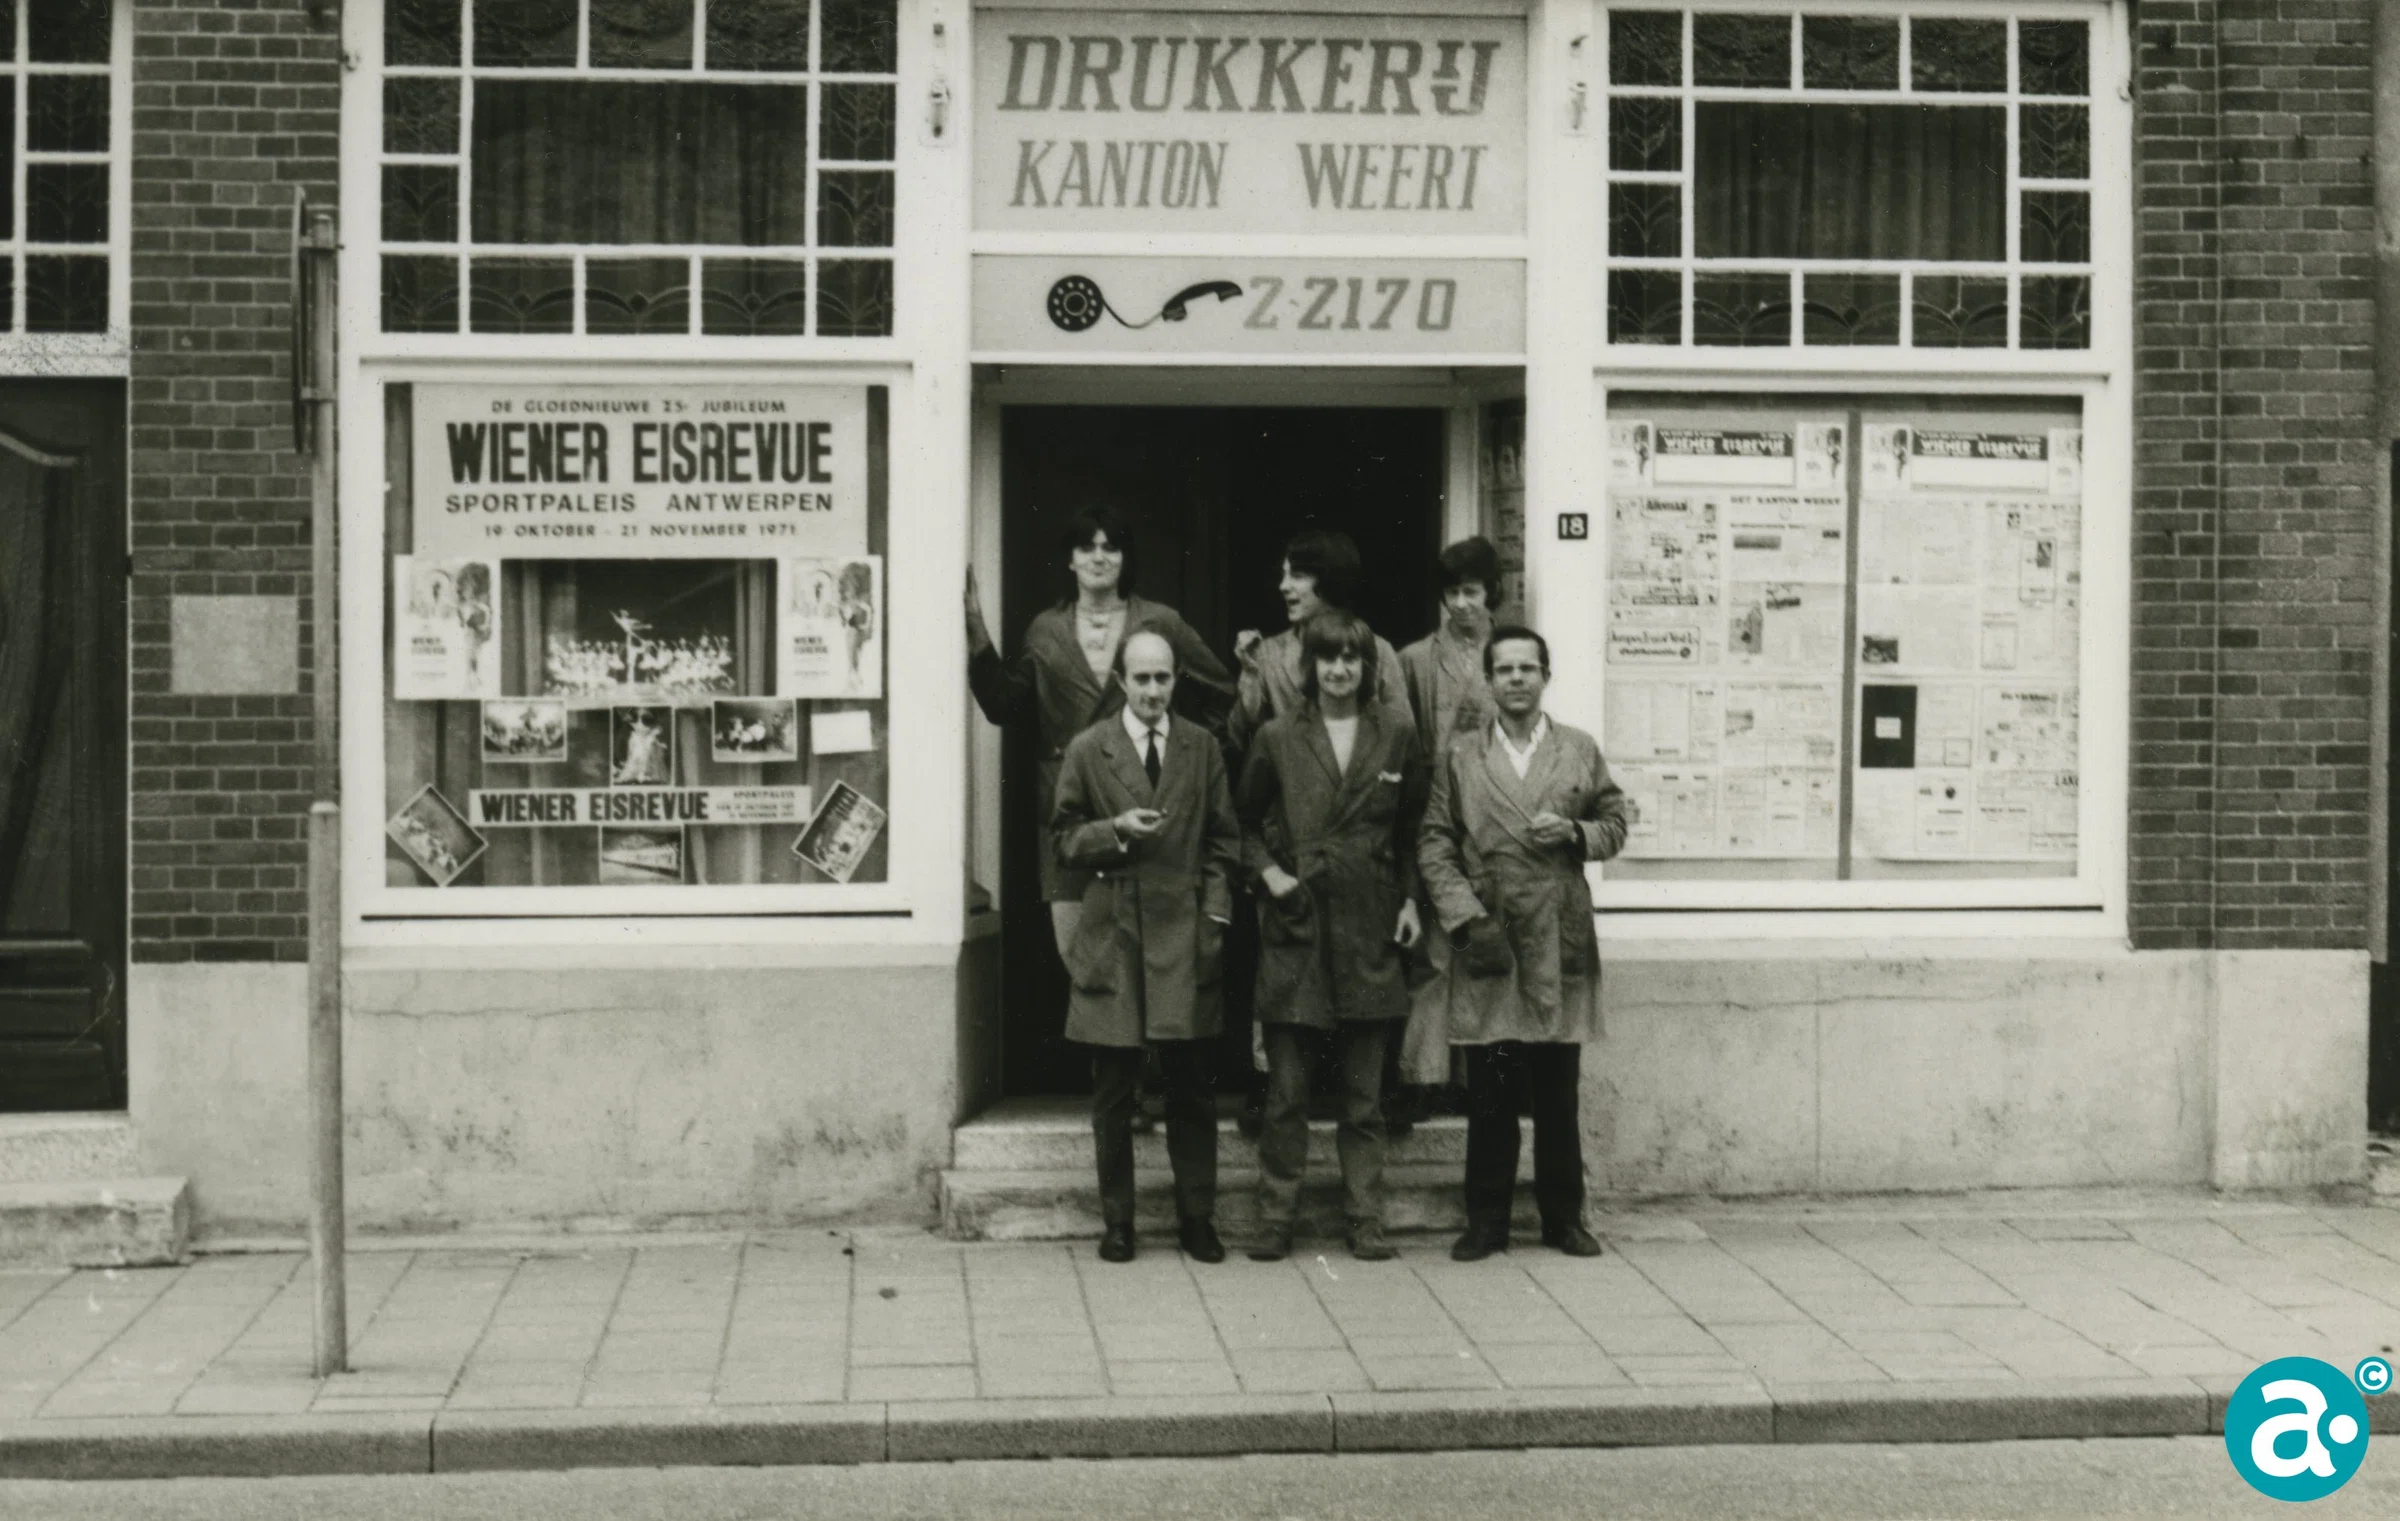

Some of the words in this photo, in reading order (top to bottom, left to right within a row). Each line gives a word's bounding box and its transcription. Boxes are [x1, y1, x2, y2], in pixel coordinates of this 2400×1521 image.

[997, 35, 1502, 117] DRUKKERIJ
[1008, 140, 1229, 209] KANTON
[1296, 143, 1489, 211] WEERT
[491, 401, 513, 413] DE
[525, 401, 650, 413] GLOEDNIEUWE
[702, 401, 787, 413] JUBILEUM
[446, 421, 608, 484] WIENER
[633, 421, 832, 484] EISREVUE
[446, 493, 636, 514] SPORTPALEIS
[666, 493, 832, 513] ANTWERPEN
[515, 524, 596, 537] OKTOBER
[651, 524, 747, 537] NOVEMBER
[1561, 516, 1585, 536] 18
[479, 794, 577, 822] WIENER
[589, 792, 709, 821] EISREVUE
